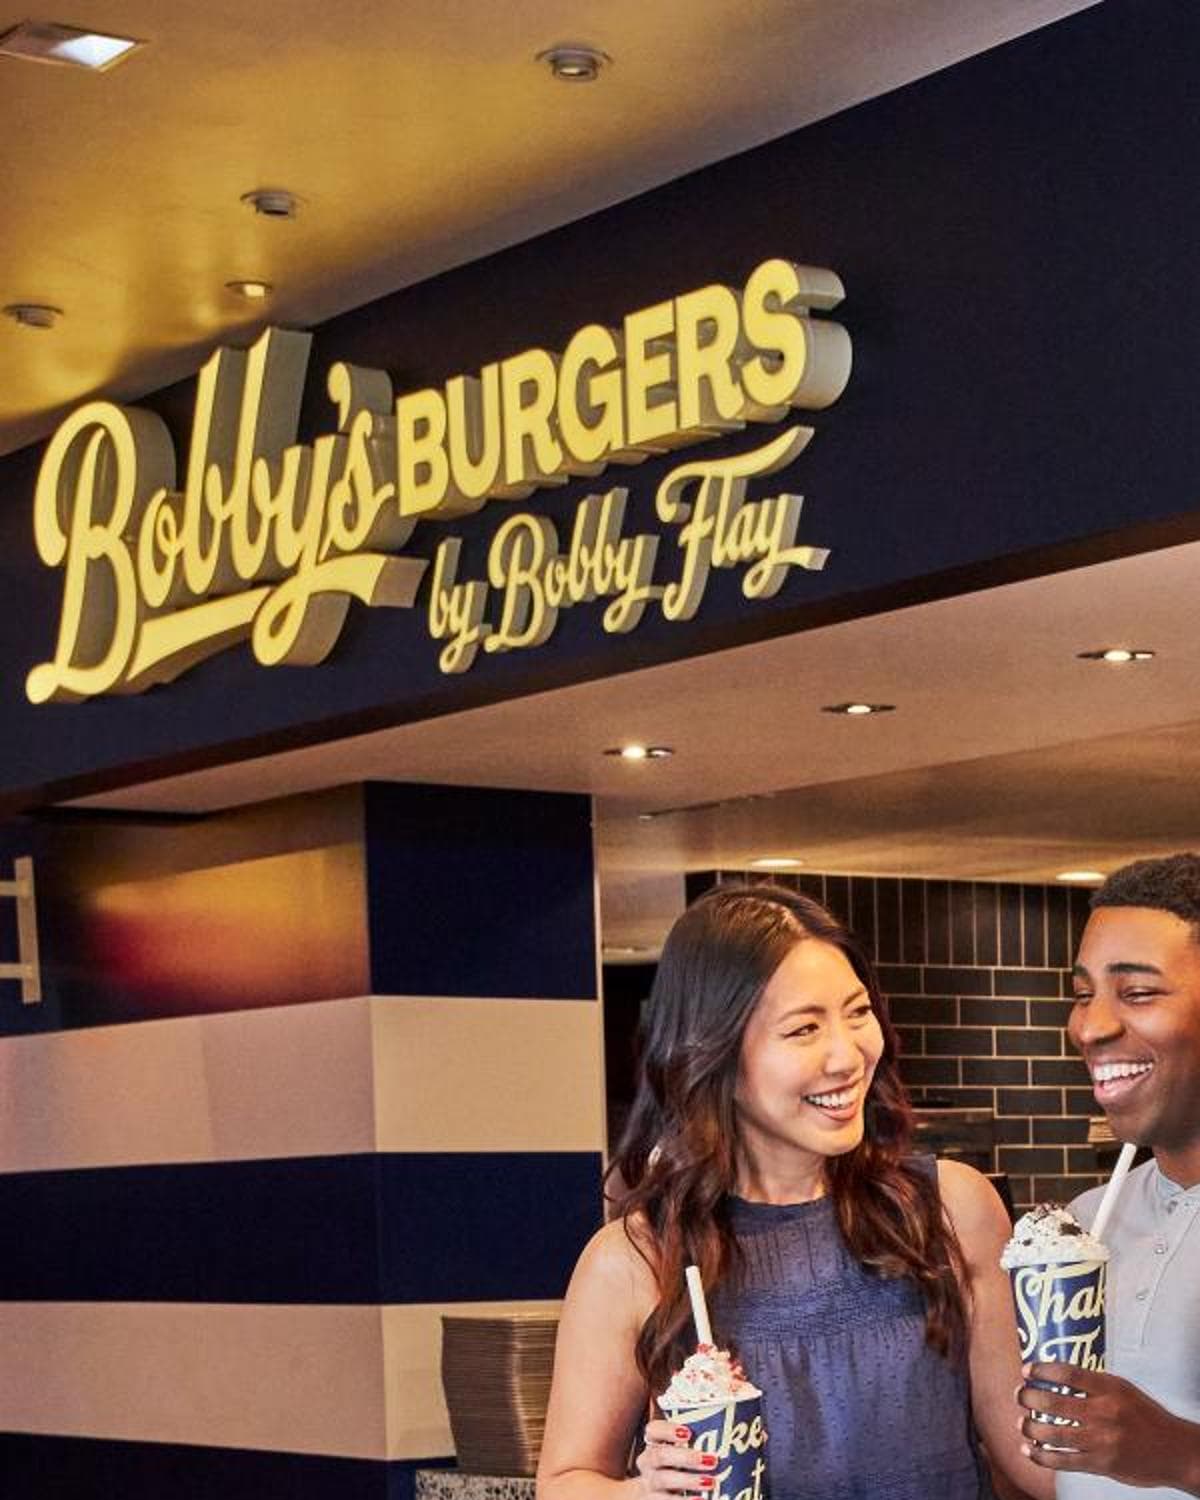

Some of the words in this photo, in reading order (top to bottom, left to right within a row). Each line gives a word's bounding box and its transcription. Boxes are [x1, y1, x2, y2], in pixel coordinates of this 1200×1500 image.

[25, 328, 420, 704] Bobby's
[398, 258, 845, 520] BURGERS
[428, 535, 488, 674] by
[485, 488, 662, 651] Bobby
[655, 426, 828, 622] Flay
[1015, 1262, 1105, 1360] Shak
